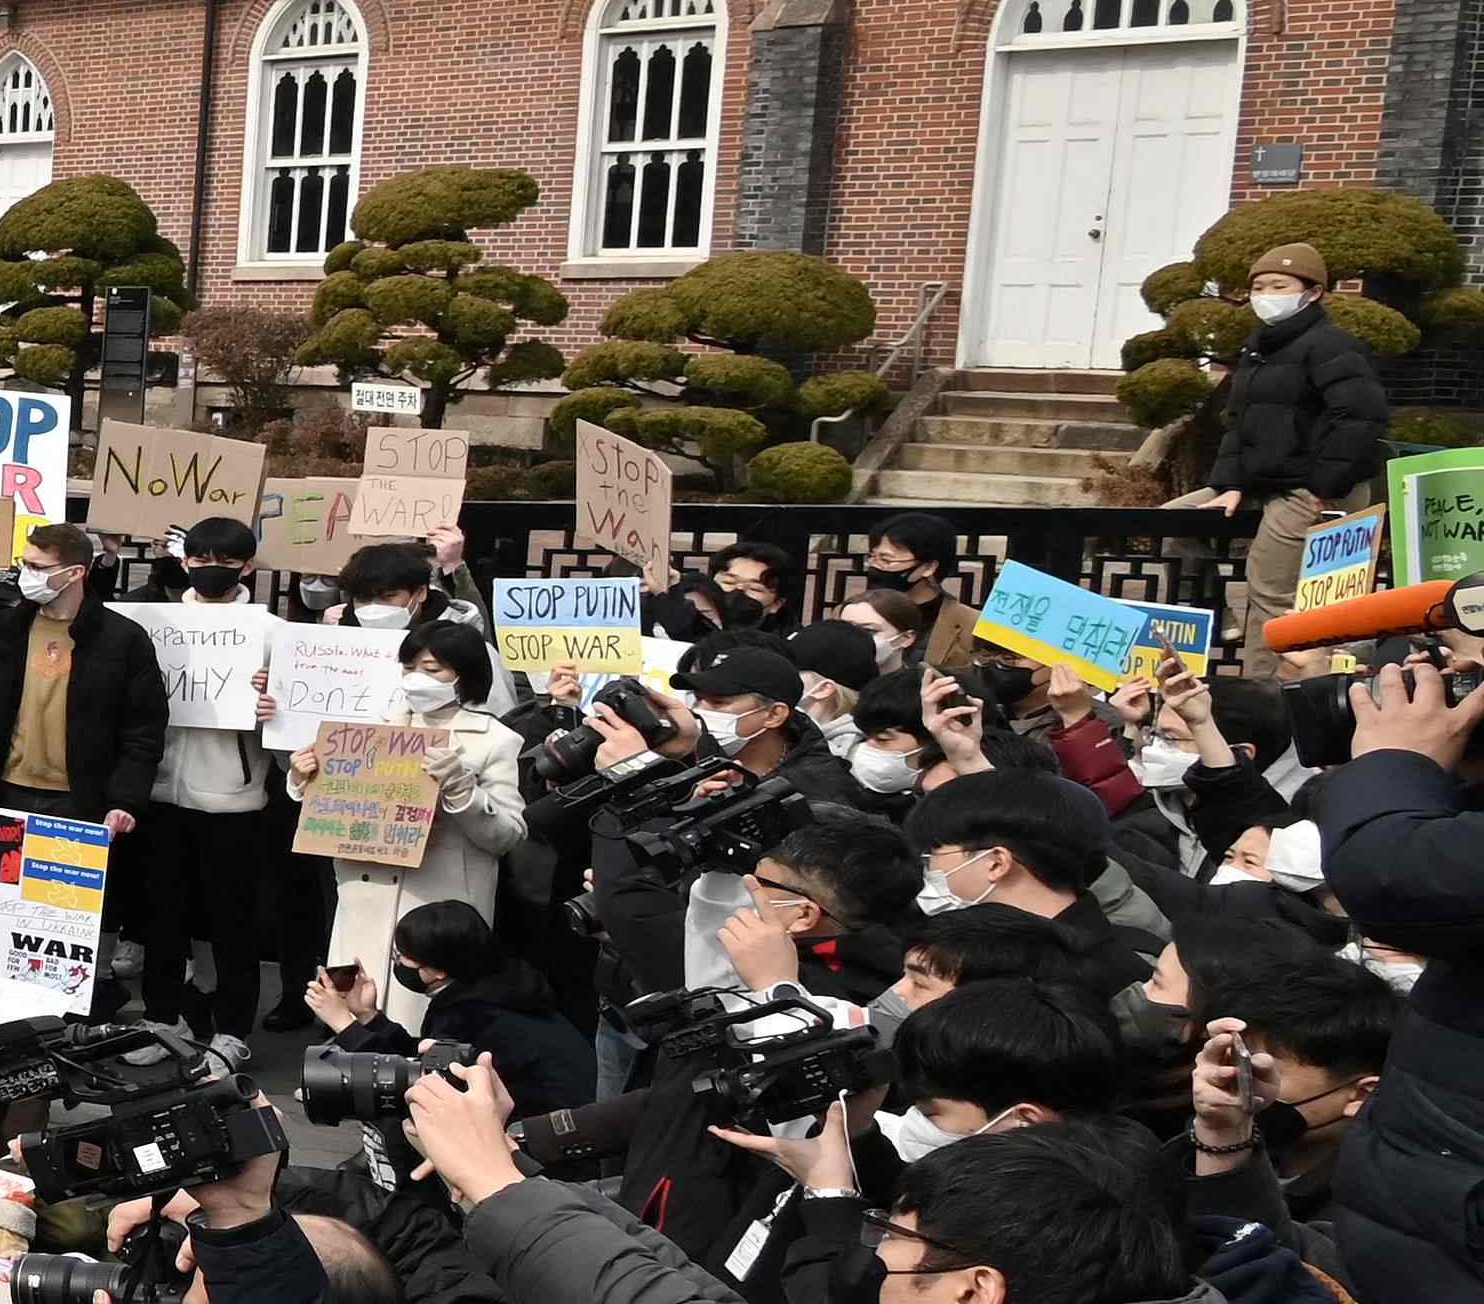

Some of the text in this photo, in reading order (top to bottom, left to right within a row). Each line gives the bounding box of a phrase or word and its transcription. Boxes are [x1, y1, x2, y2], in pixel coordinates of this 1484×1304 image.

[397, 390, 418, 409] 주차
[377, 434, 468, 473] STOP
[591, 438, 660, 495] Stop
[170, 452, 247, 506] War
[368, 478, 398, 492] THE
[599, 483, 649, 514] the
[1308, 520, 1378, 568] STOP PUTIN
[503, 585, 637, 620] STOP PUTIN
[1300, 572, 1367, 612] STOP WAR
[992, 587, 1051, 634] 전쟁을
[505, 634, 622, 661] STOP WAR
[323, 729, 376, 756] STOP
[323, 758, 364, 777] STOP
[10, 931, 95, 964] WAR
